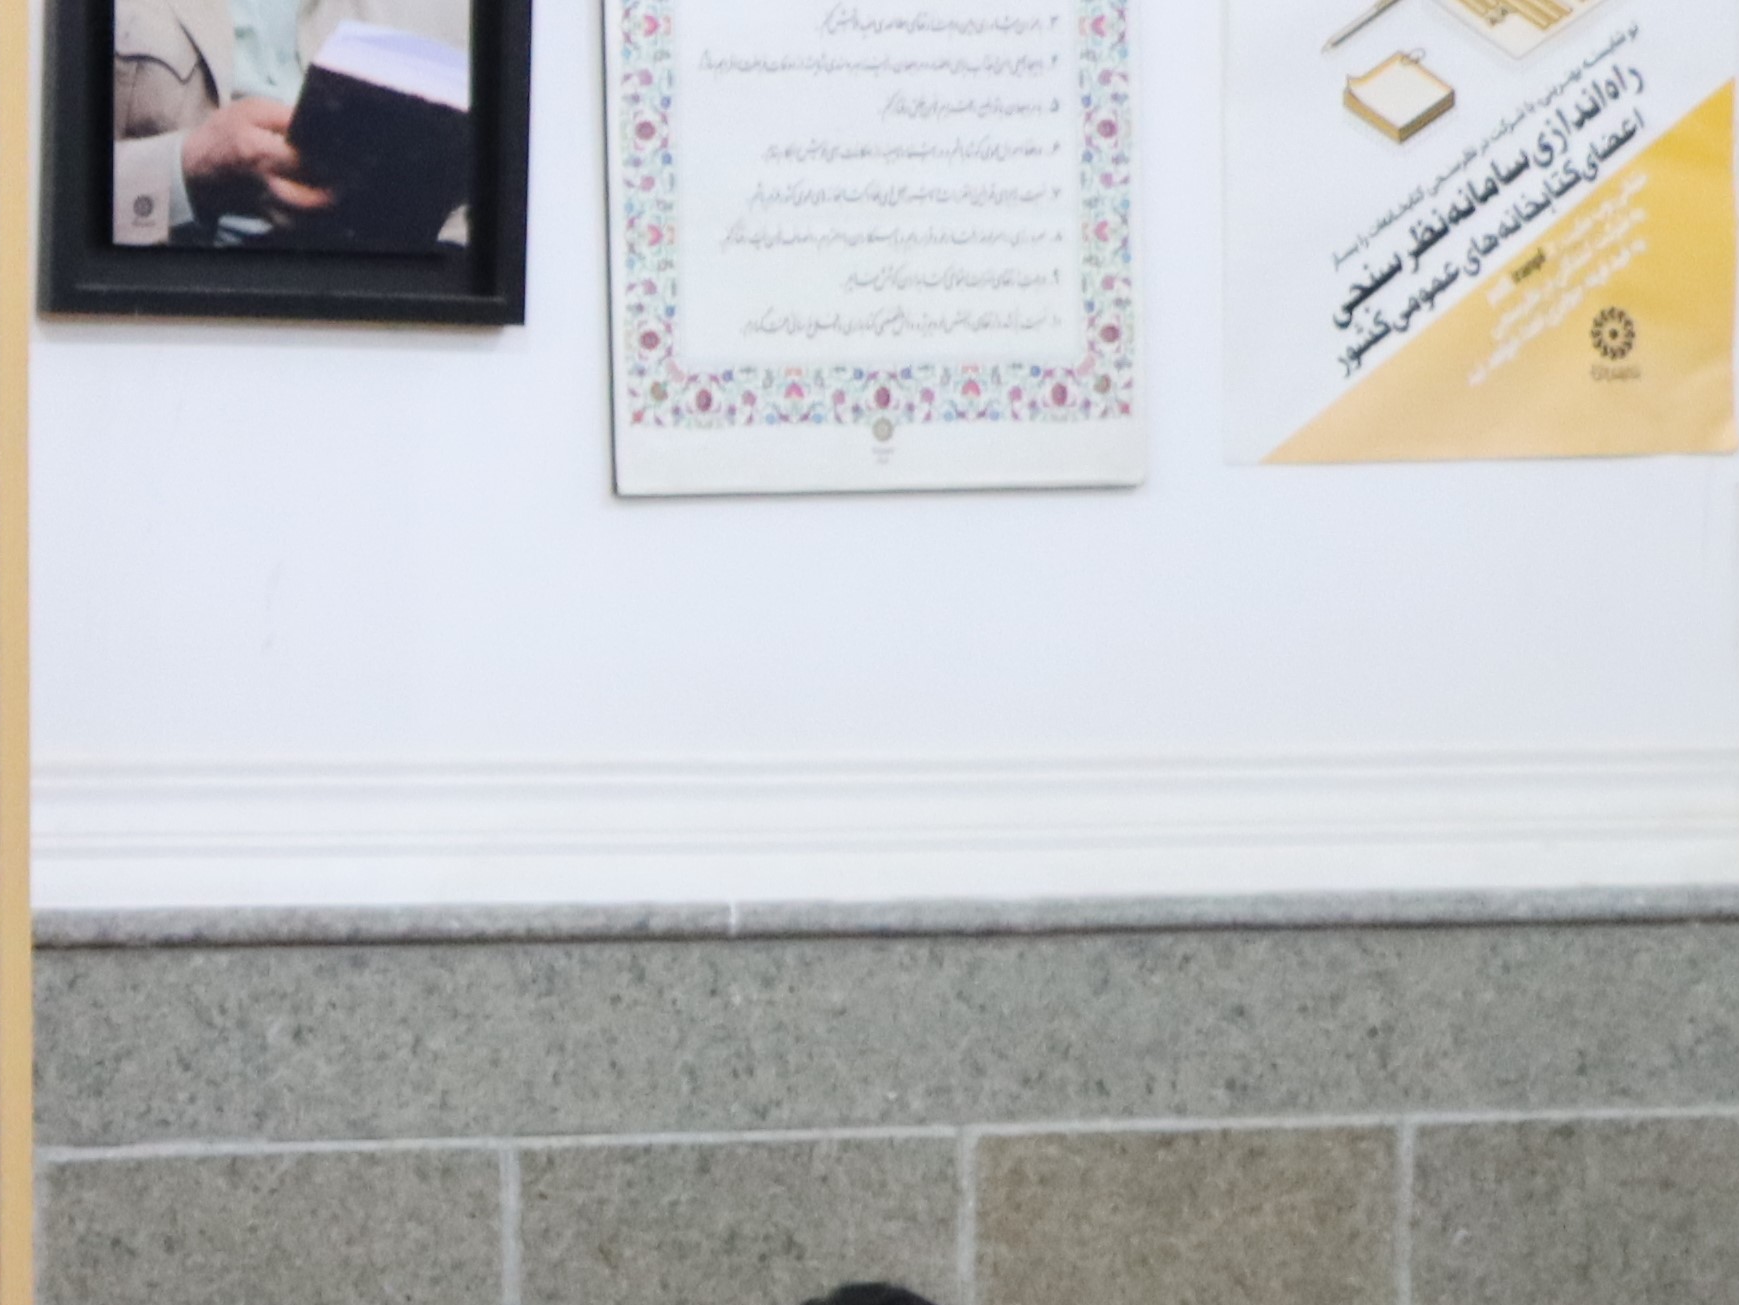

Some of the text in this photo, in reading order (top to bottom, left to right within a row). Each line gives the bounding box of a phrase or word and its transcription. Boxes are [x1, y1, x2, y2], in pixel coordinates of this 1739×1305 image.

[1580, 106, 1645, 182] اعضای
[1449, 147, 1531, 226] سامانه
[1390, 260, 1461, 333] عمومی
[1336, 312, 1393, 378] کشور
